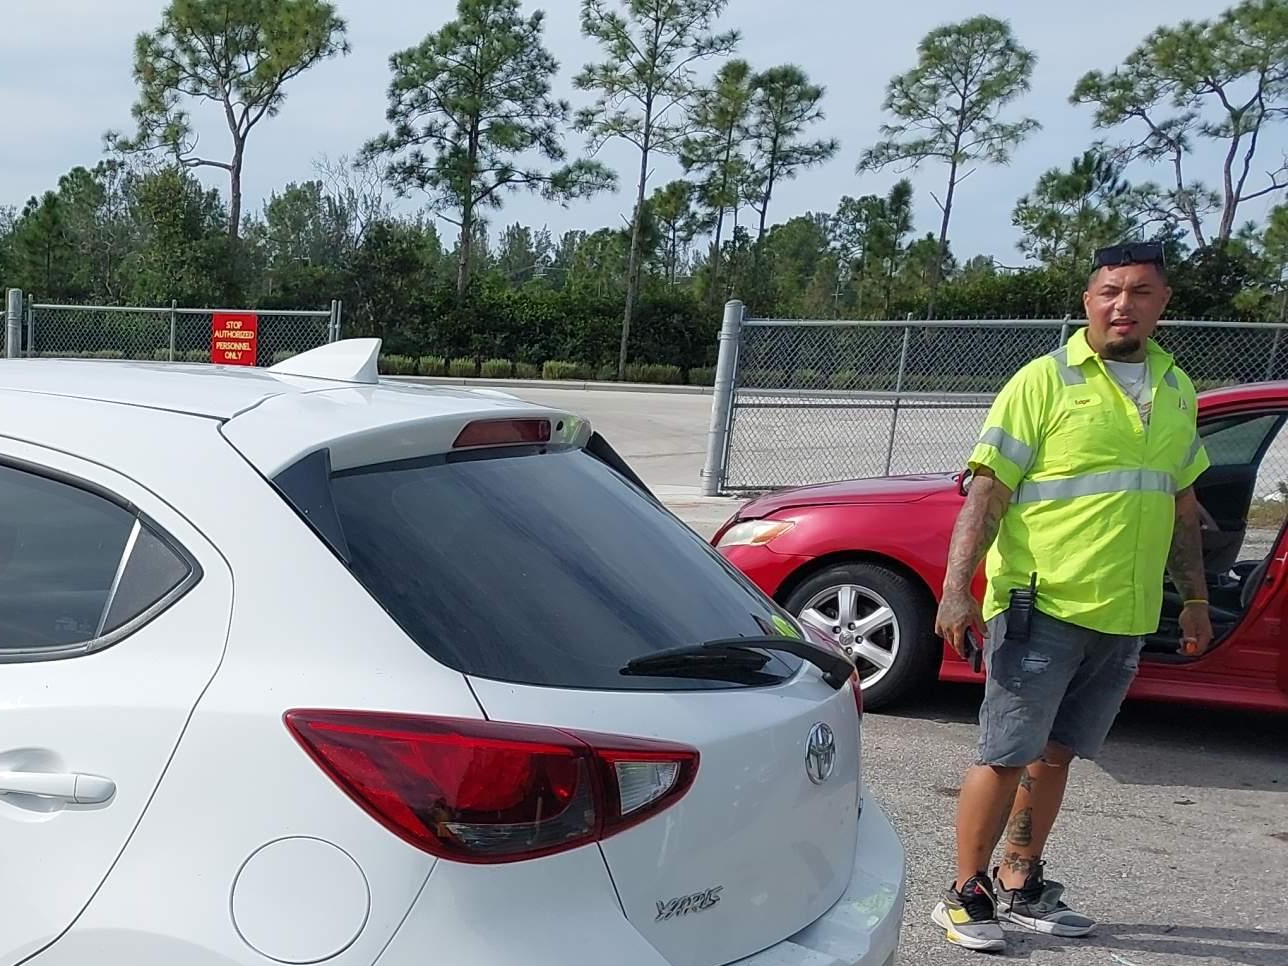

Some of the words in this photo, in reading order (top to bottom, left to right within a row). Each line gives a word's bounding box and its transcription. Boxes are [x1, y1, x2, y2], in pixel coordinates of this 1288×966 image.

[226, 321, 243, 329] STOP
[214, 330, 255, 339] AUTHORIZED
[215, 341, 252, 351] PERSONNEL
[224, 351, 243, 360] ONLY
[655, 885, 724, 921] YARIS
